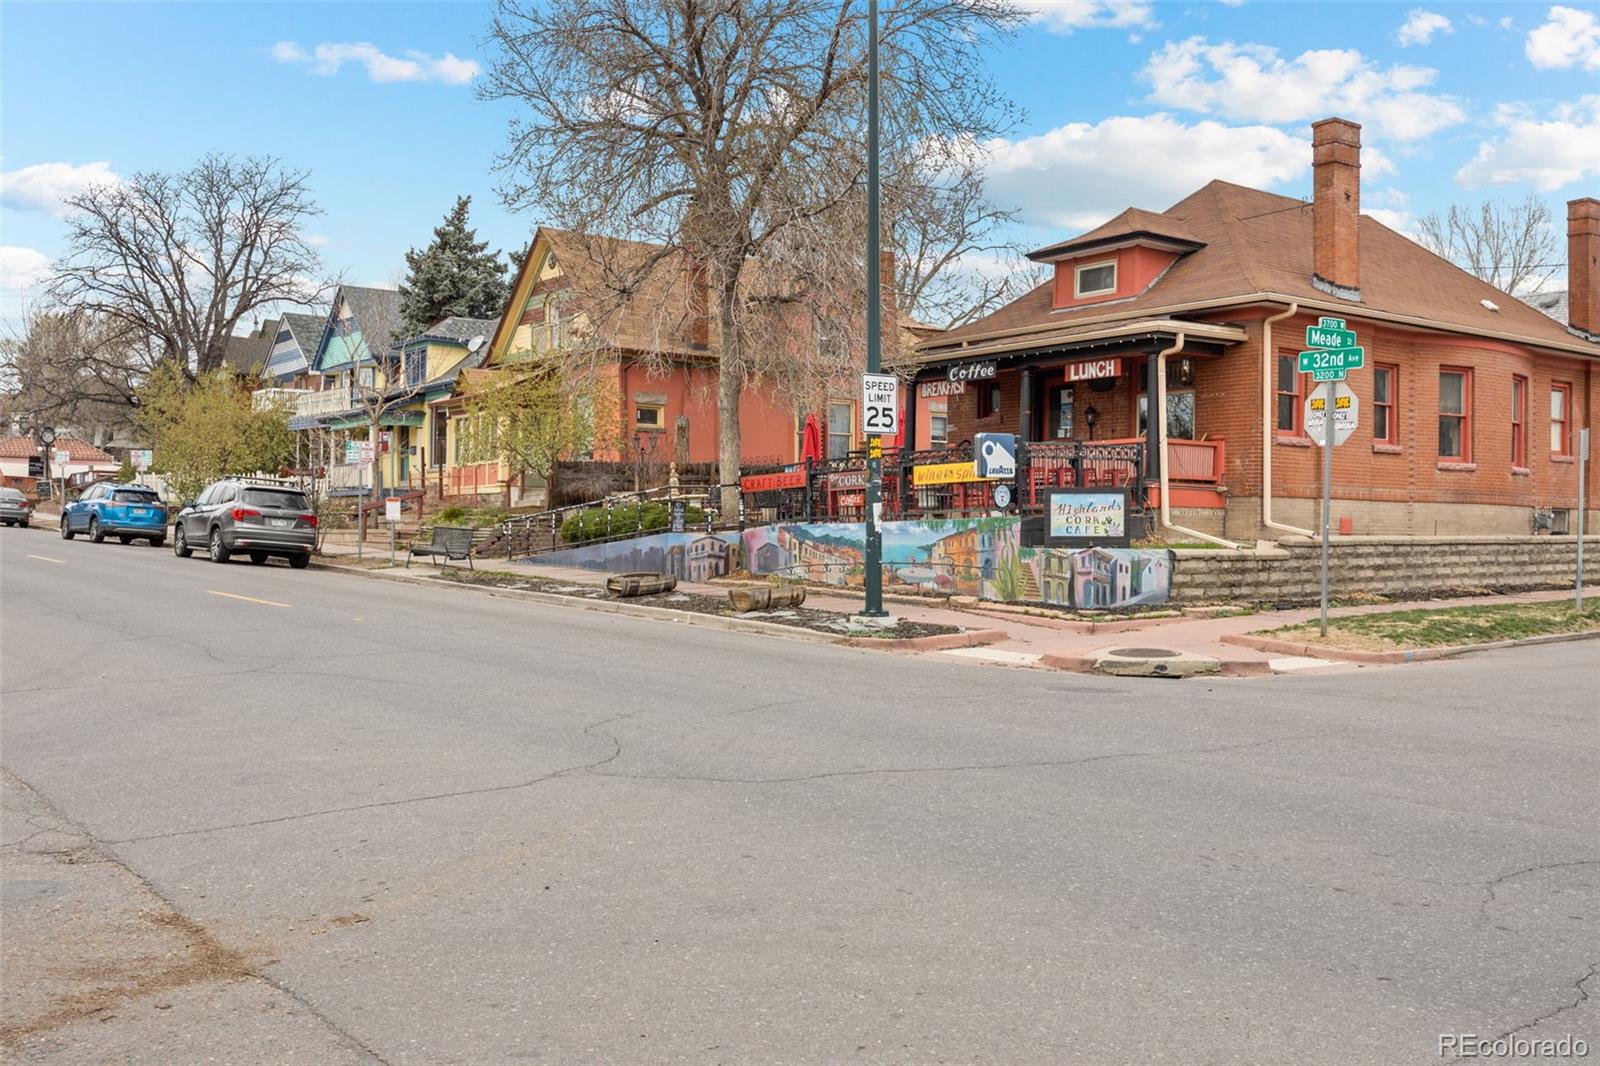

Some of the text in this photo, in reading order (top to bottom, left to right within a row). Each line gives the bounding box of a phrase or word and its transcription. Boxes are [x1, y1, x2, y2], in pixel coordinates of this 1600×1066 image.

[1321, 319, 1345, 329] 3700 W
[1311, 330, 1353, 347] Meade St
[1302, 352, 1360, 368] W 32nd Ave
[949, 364, 994, 381] Coffee
[1069, 359, 1115, 381] LUNCH
[1315, 370, 1344, 380] 3200 N
[865, 381, 895, 391] SPEED
[868, 393, 891, 403] LIMIT
[866, 406, 894, 428] 25
[918, 469, 943, 481] wine
[989, 465, 1014, 474] LAVAZZA
[744, 475, 803, 489] CRAFT BEER
[839, 475, 865, 487] CORK
[1053, 499, 1122, 516] Highlands
[1065, 515, 1100, 525] CORK
[1065, 525, 1100, 535] CAFE
